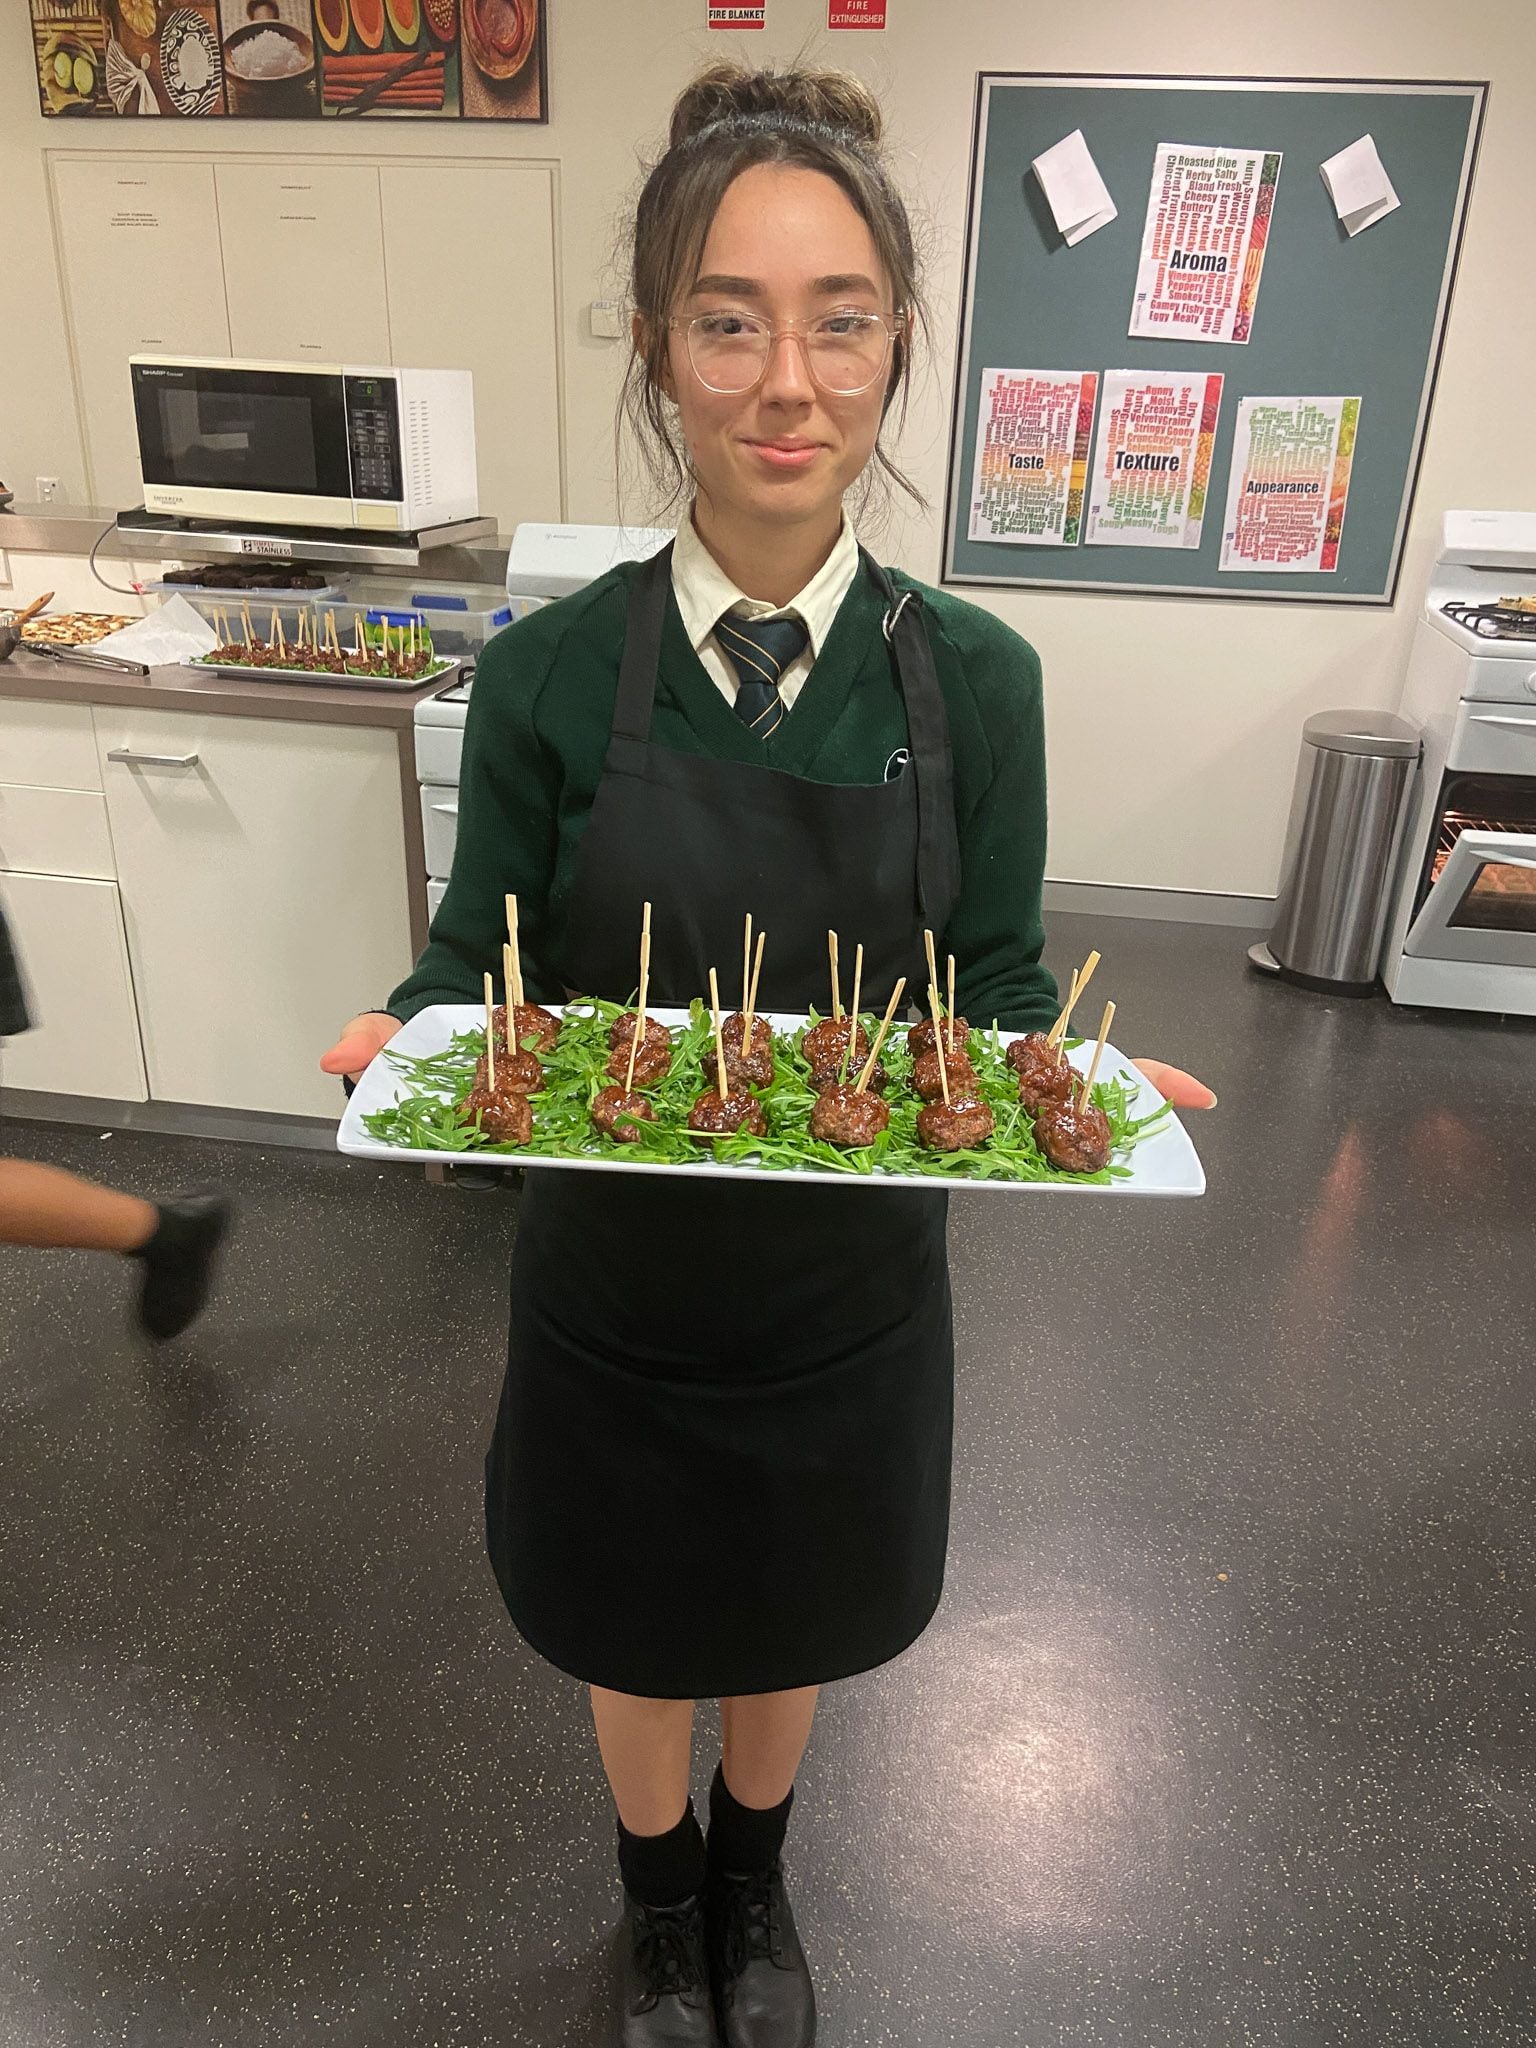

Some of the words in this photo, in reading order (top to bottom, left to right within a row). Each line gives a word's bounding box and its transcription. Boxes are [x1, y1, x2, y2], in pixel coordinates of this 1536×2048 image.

[847, 1, 868, 10] FIRE
[709, 10, 726, 19] FIRE
[728, 10, 765, 19] BLANKET
[830, 14, 884, 24] EXTINGUISHER
[1178, 156, 1215, 168] Roasted
[1217, 157, 1237, 168] Ripe
[1173, 167, 1184, 191] Fried
[1186, 170, 1212, 182] Herby
[1215, 168, 1238, 180] Salty
[1243, 160, 1256, 186] Nutty
[1160, 155, 1176, 205] Chocolaty
[1189, 181, 1215, 191] Bland
[1217, 181, 1242, 191] Fresh
[1185, 191, 1217, 203] Cheesy
[1167, 194, 1181, 221] Fruity
[1181, 201, 1213, 214] Buttery
[1216, 195, 1230, 225] Earthy
[1228, 192, 1242, 225] Woody
[1238, 187, 1253, 227] Savoury
[1175, 213, 1189, 247] Citrusy
[1186, 213, 1200, 252] Garlicky
[1199, 216, 1212, 251] Pickled
[1211, 228, 1222, 250] Sour
[1221, 226, 1233, 252] Burnt
[1170, 250, 1227, 272] Aroma
[1168, 270, 1207, 283] Vinegary
[1168, 281, 1204, 292] Peppery
[1203, 273, 1217, 305] Oniony
[1213, 274, 1227, 305] Yeasty
[1223, 271, 1238, 308] Toasted
[1169, 290, 1202, 302] Smokey
[1150, 300, 1179, 311] Gamey
[1182, 304, 1204, 315] Fishy
[1149, 311, 1169, 322] Eggy
[1172, 312, 1199, 324] Meaty
[1212, 309, 1225, 334] Minty
[1146, 385, 1173, 396] Runny
[1123, 389, 1134, 413] Flaky
[1133, 391, 1145, 413] Fatty
[1150, 396, 1174, 406] Moist
[1178, 387, 1191, 416] Soggy
[1144, 404, 1177, 415] Creamy
[1187, 402, 1197, 418] Dry
[1130, 413, 1163, 424] Velvety
[1163, 416, 1191, 427] Grainy
[1108, 409, 1120, 443] Spongy
[1117, 413, 1129, 445] Greasy
[1134, 424, 1166, 435] Stringy
[1167, 427, 1194, 437] Gooey
[1127, 433, 1164, 445] Crunchy
[1164, 437, 1192, 447] Crispy
[1009, 454, 1044, 469] Taste
[1116, 451, 1179, 471] Texture
[1107, 480, 1119, 508] Sticky
[1247, 481, 1318, 494] Appearance
[1174, 484, 1186, 514] Tender
[1113, 501, 1124, 520] Fizzy
[1124, 508, 1157, 518] Mashed
[1159, 496, 1171, 525] Chewy
[1098, 519, 1123, 529] Soupy
[1124, 518, 1153, 528] Mushy
[1153, 524, 1179, 535] Tough
[257, 546, 291, 556] STAINLESS
